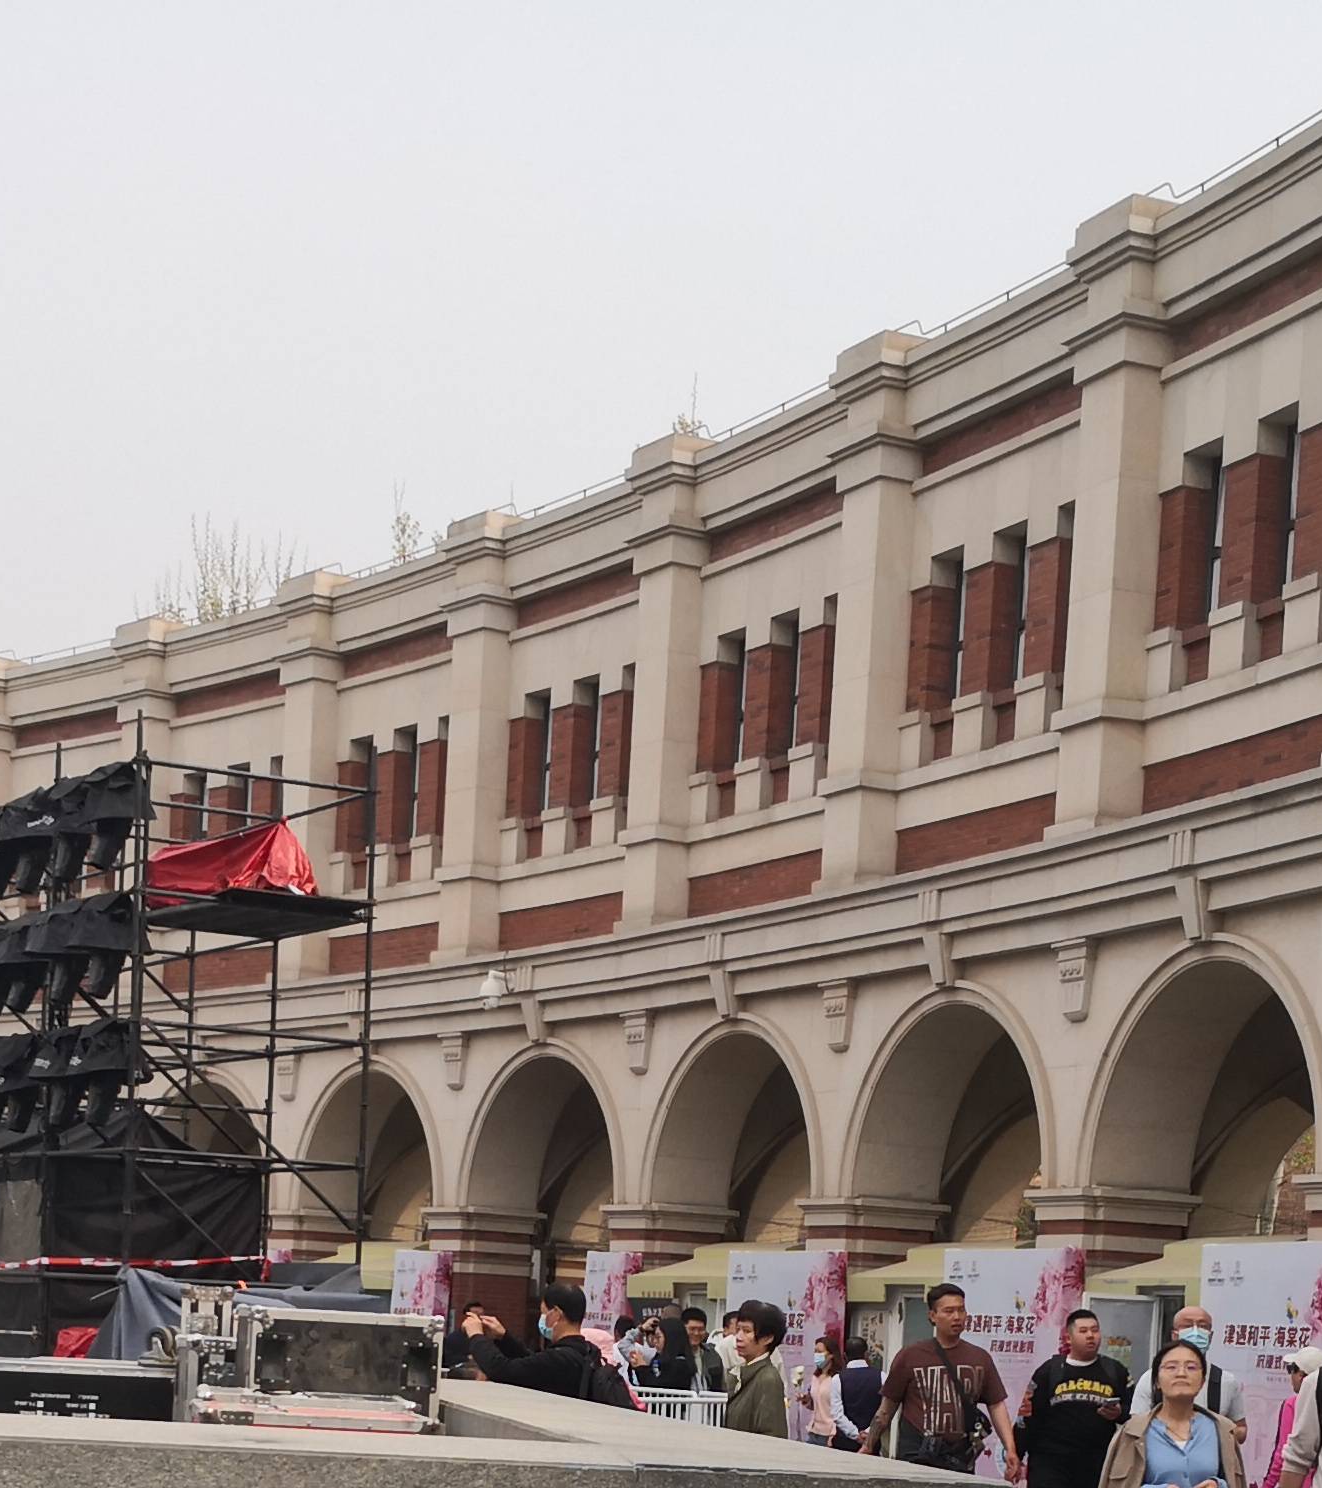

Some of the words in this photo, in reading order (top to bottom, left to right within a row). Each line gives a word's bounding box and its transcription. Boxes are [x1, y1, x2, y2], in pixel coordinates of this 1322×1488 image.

[1223, 1324, 1271, 1346] 津遇和平
[1273, 1326, 1311, 1348] 海棠花
